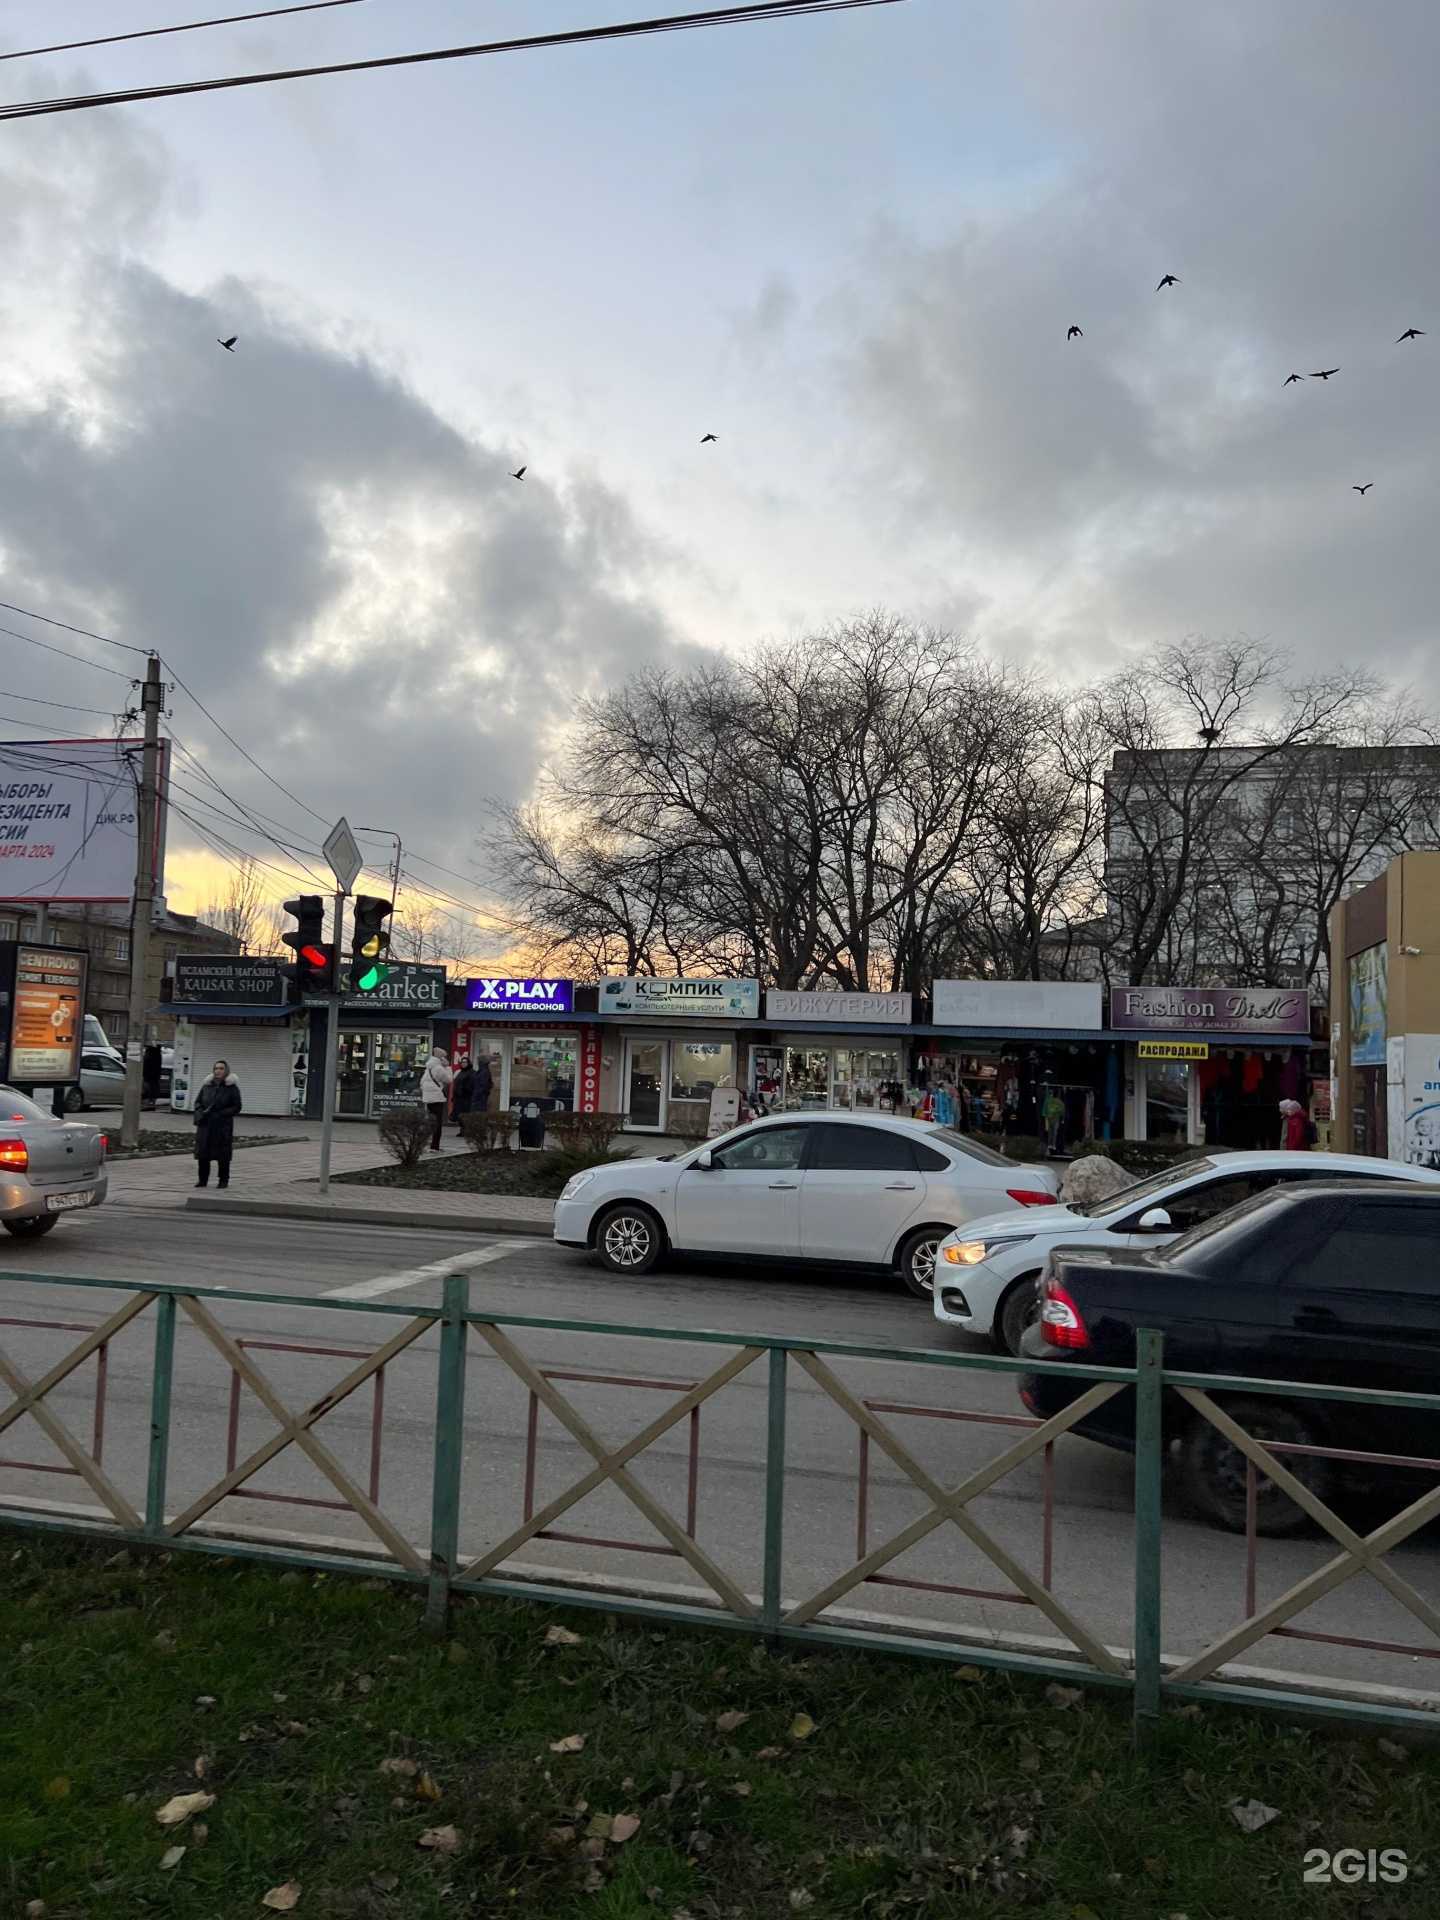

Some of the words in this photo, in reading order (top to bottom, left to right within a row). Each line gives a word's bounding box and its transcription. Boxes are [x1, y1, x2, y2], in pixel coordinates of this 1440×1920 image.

[28, 845, 55, 858] 2024
[236, 967, 276, 977] МАГАЗИН
[184, 978, 234, 991] KAUSAR
[239, 979, 274, 992] SHOP
[355, 975, 439, 1000] arket
[510, 1002, 565, 1011] ТЕЛЕФОНОВ
[775, 998, 905, 1016] БИЖУТЕРИЯ
[1124, 992, 1215, 1017] Fashion
[1140, 1045, 1206, 1057] РАСПРОДАЖА
